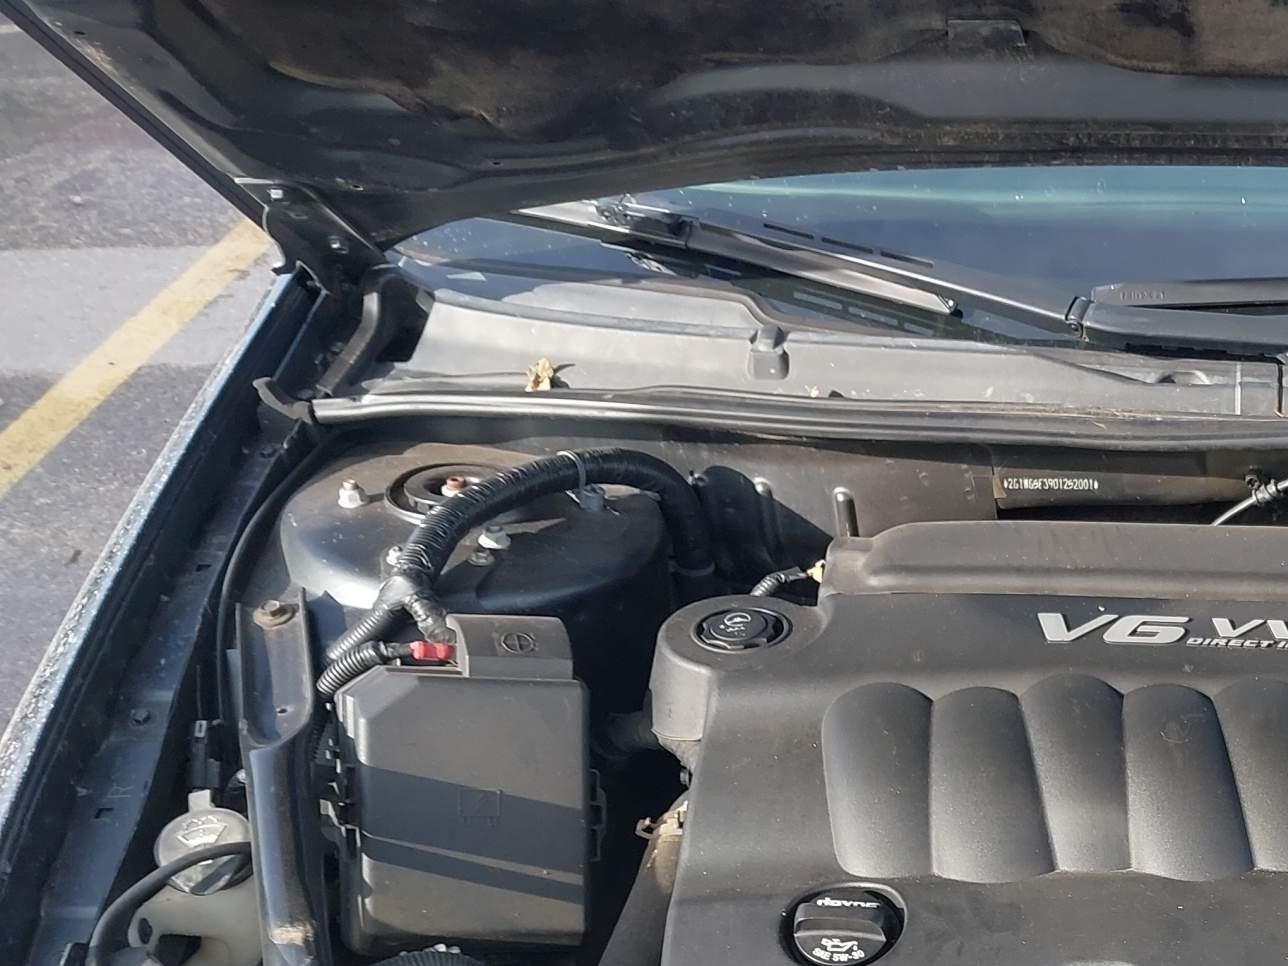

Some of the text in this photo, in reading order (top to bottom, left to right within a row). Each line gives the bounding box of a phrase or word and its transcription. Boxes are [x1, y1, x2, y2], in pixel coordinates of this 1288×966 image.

[1037, 612, 1191, 644] V6
[1186, 637, 1274, 649] DIRECT
[812, 947, 865, 961] SAE 5W-30
